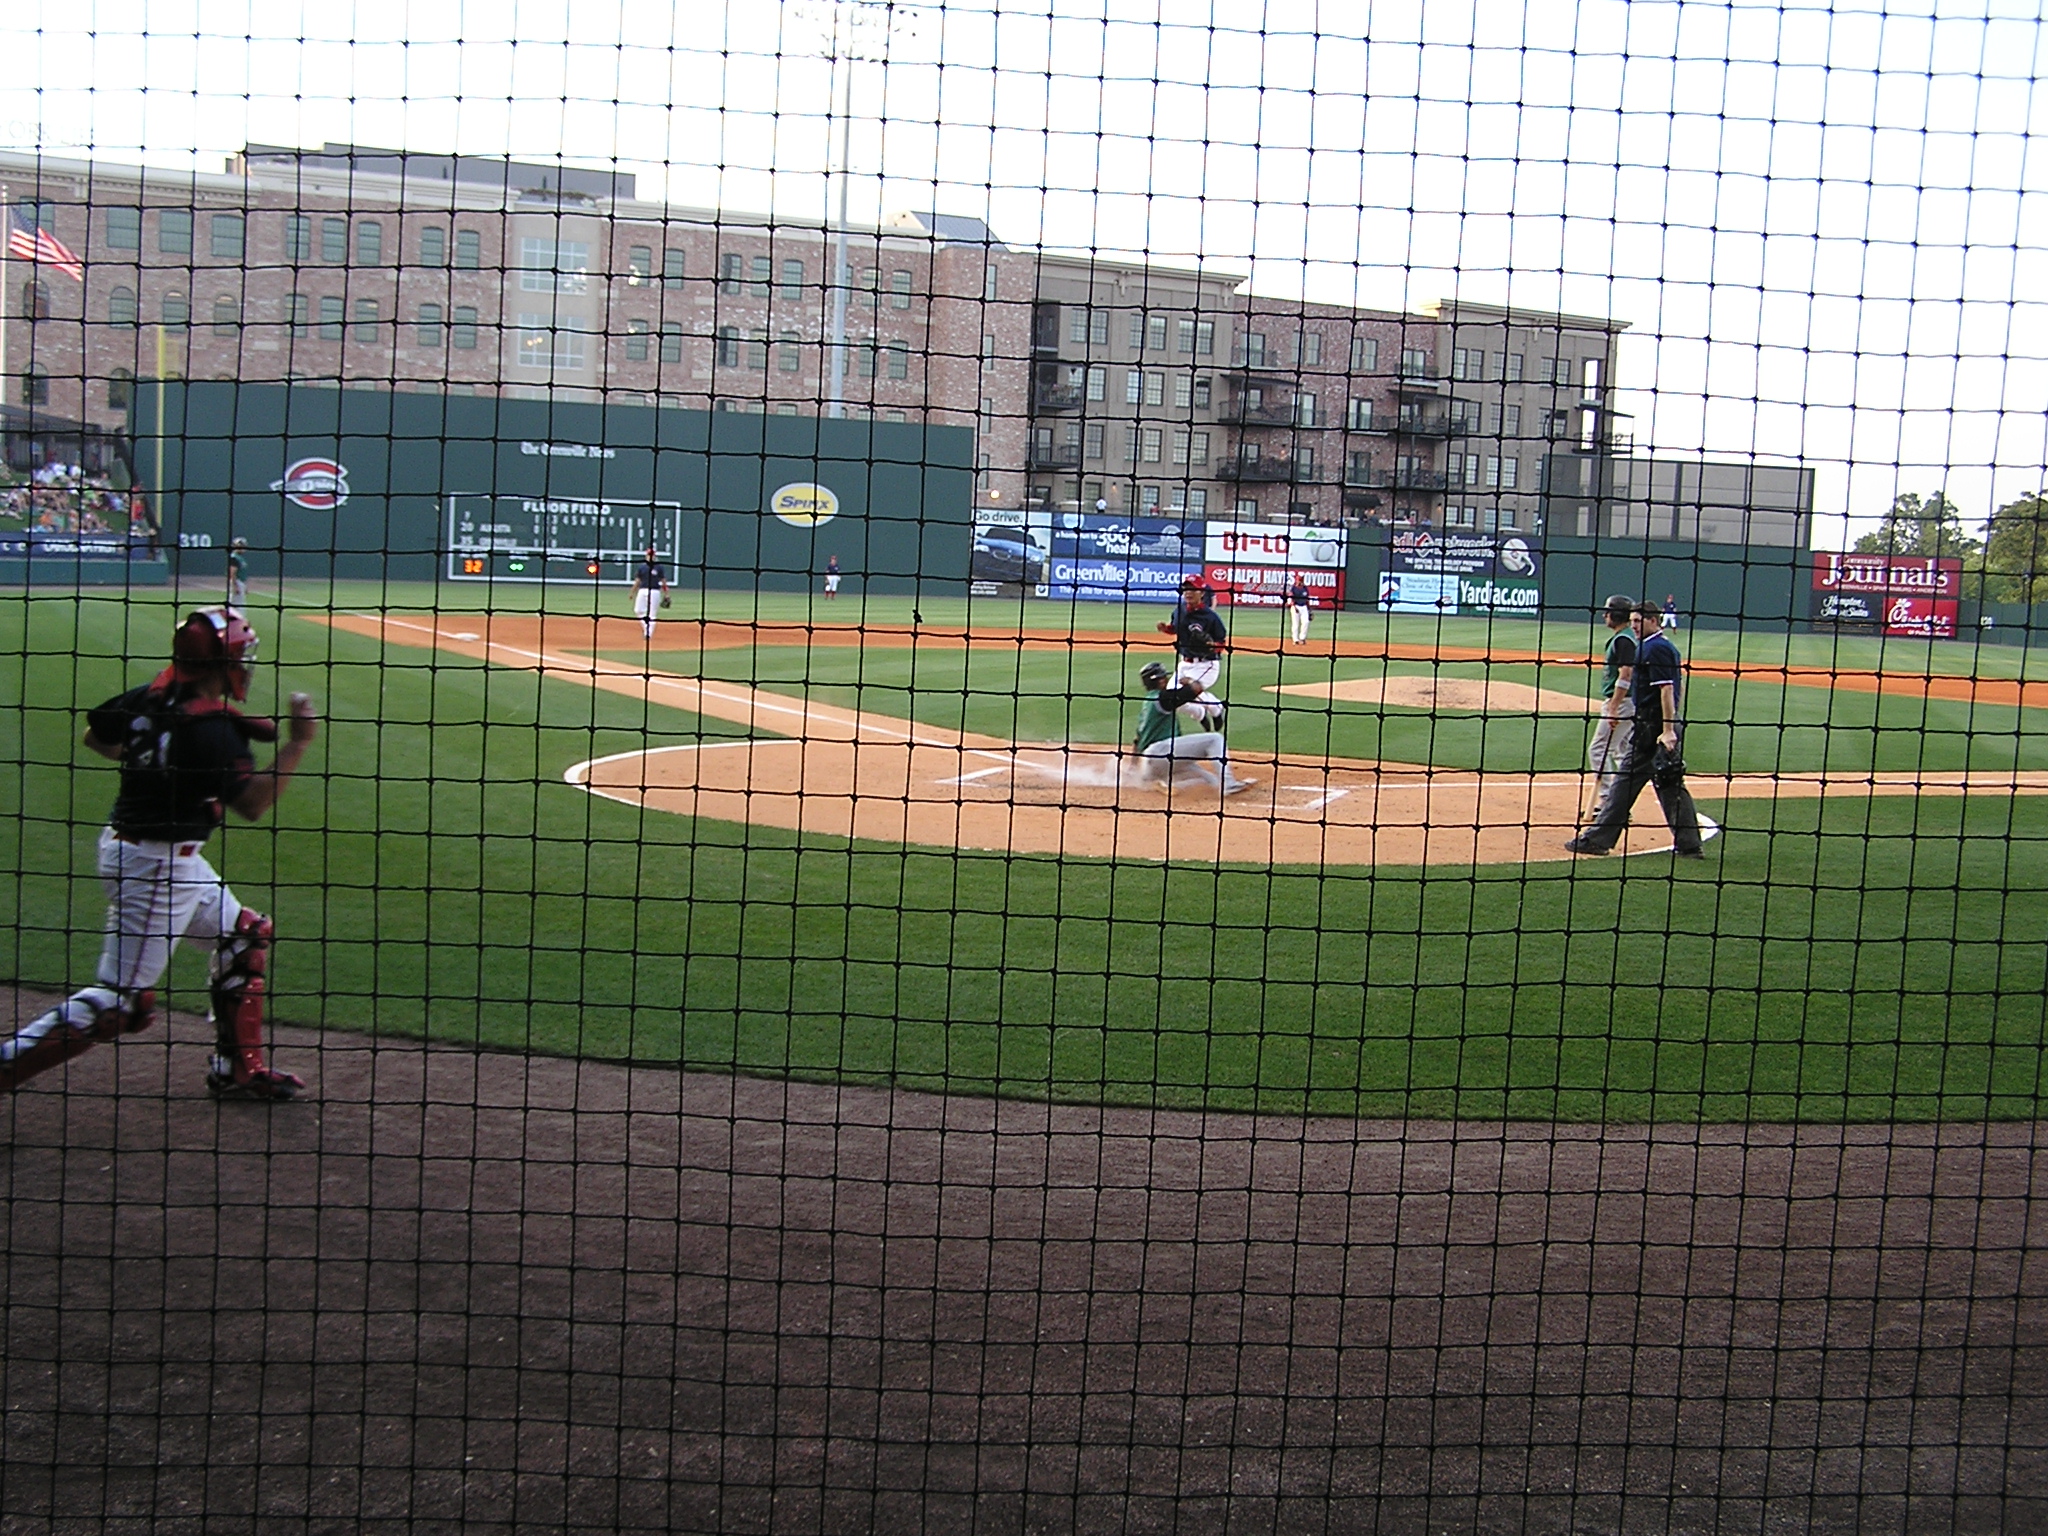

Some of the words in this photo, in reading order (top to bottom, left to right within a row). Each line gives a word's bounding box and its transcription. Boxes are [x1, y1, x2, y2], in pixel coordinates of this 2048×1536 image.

[523, 501, 569, 514] FLUOR
[571, 503, 610, 515] FIELD
[974, 511, 989, 521] Go
[992, 512, 1023, 523] drive.
[180, 534, 211, 548] 310
[1106, 542, 1141, 555] health
[1227, 568, 1261, 584] RALPH
[1263, 570, 1296, 586] HAYES
[1822, 554, 1948, 588] Journals
[1460, 580, 1539, 606] Yardiac.com
